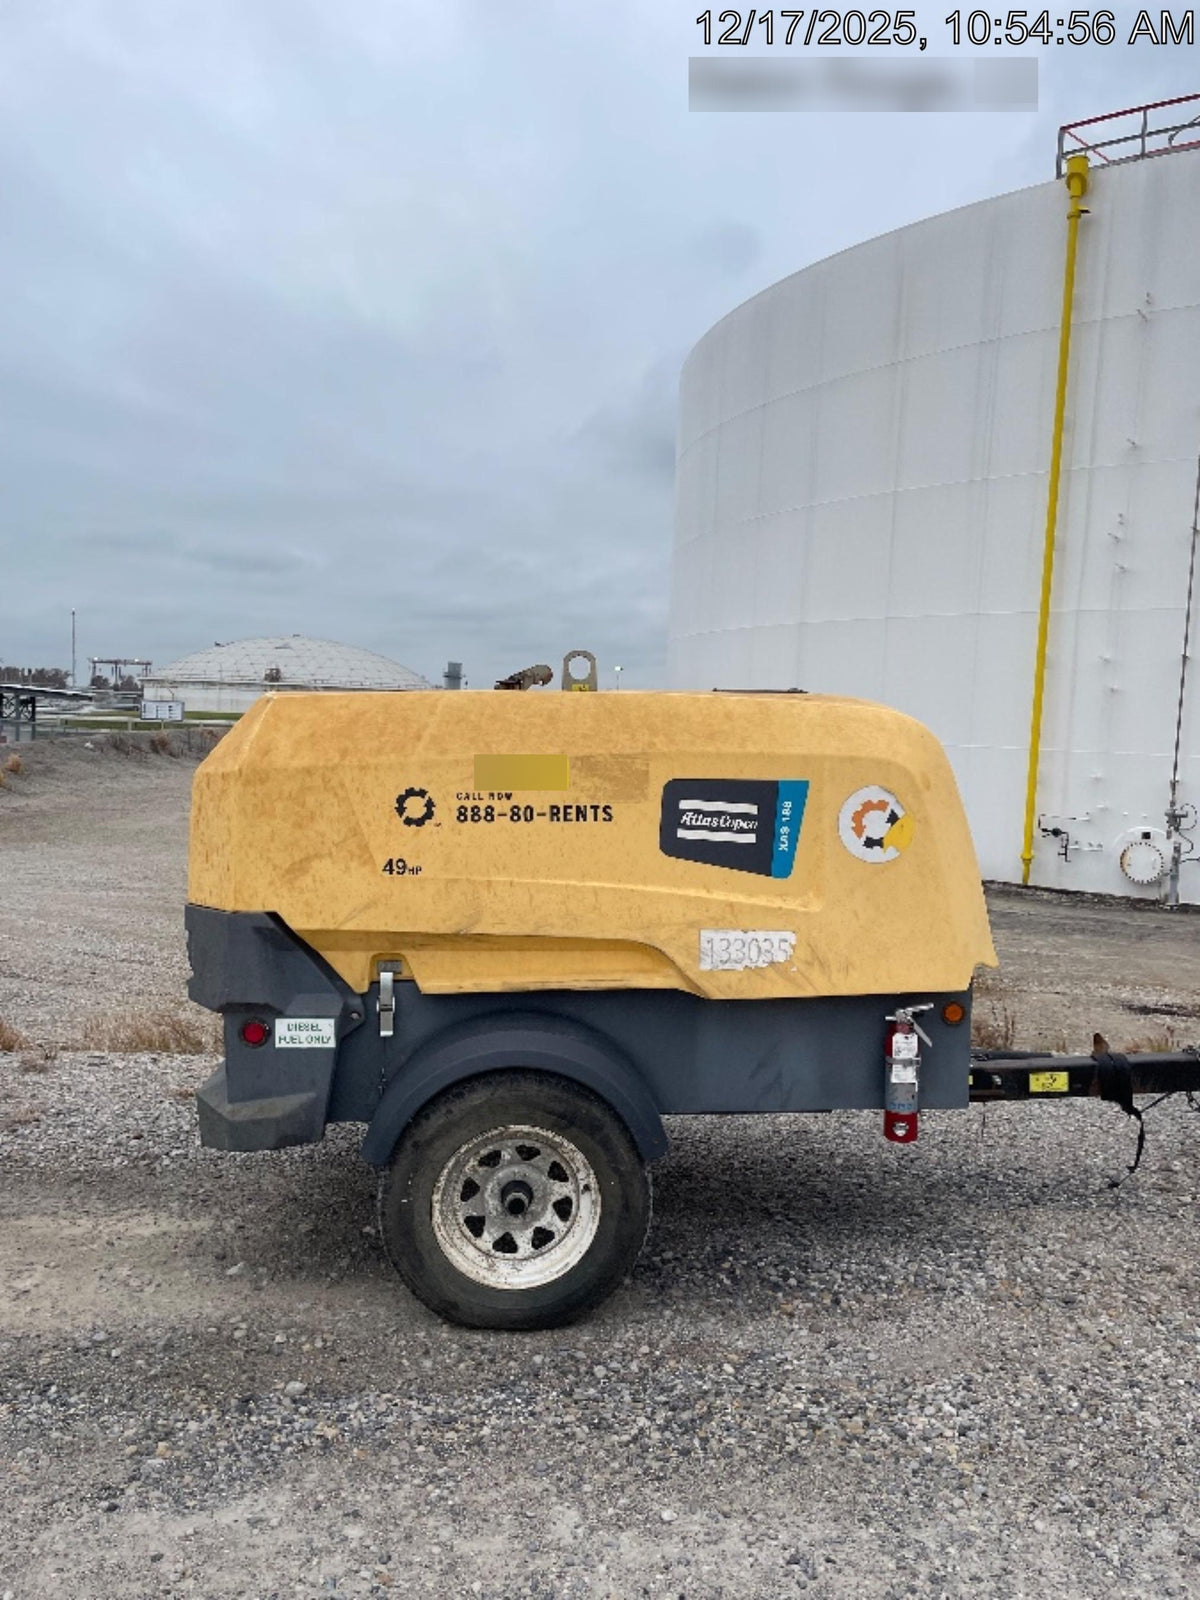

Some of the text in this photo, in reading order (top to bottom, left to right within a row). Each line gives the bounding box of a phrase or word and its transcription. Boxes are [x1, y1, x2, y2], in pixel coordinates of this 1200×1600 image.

[456, 792, 513, 801] CALL NOW
[456, 804, 614, 823] 888-80-RENTS
[781, 800, 793, 823] 188
[706, 937, 789, 965] 133035
[286, 1022, 323, 1032] DIESEL
[278, 1034, 332, 1045] FUEL ONLY
